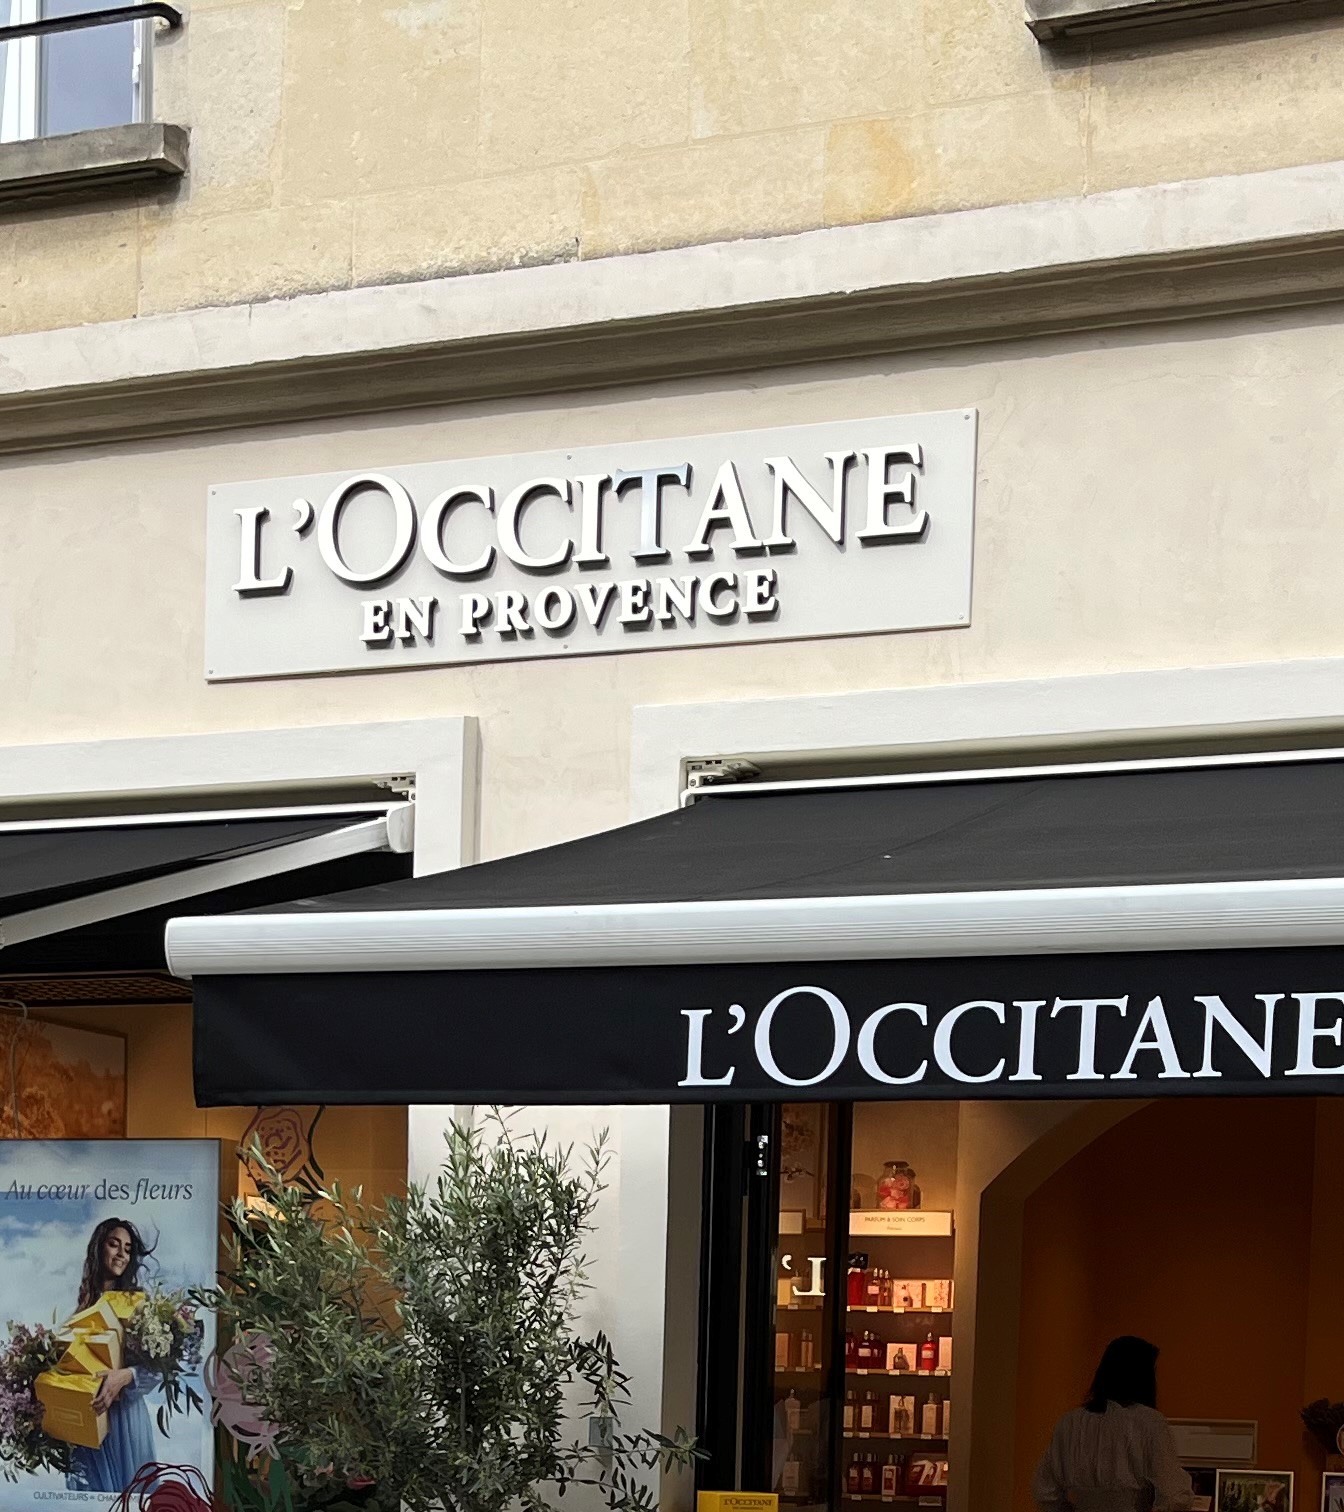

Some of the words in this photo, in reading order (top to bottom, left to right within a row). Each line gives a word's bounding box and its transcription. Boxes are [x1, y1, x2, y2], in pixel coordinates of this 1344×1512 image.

[231, 442, 930, 598] L'OCCITANE
[360, 595, 438, 648] EN
[457, 567, 780, 644] PROVENCE
[6, 1179, 33, 1201] Au
[36, 1182, 90, 1201] cœur
[94, 1179, 130, 1201] des
[130, 1178, 194, 1205] fleurs
